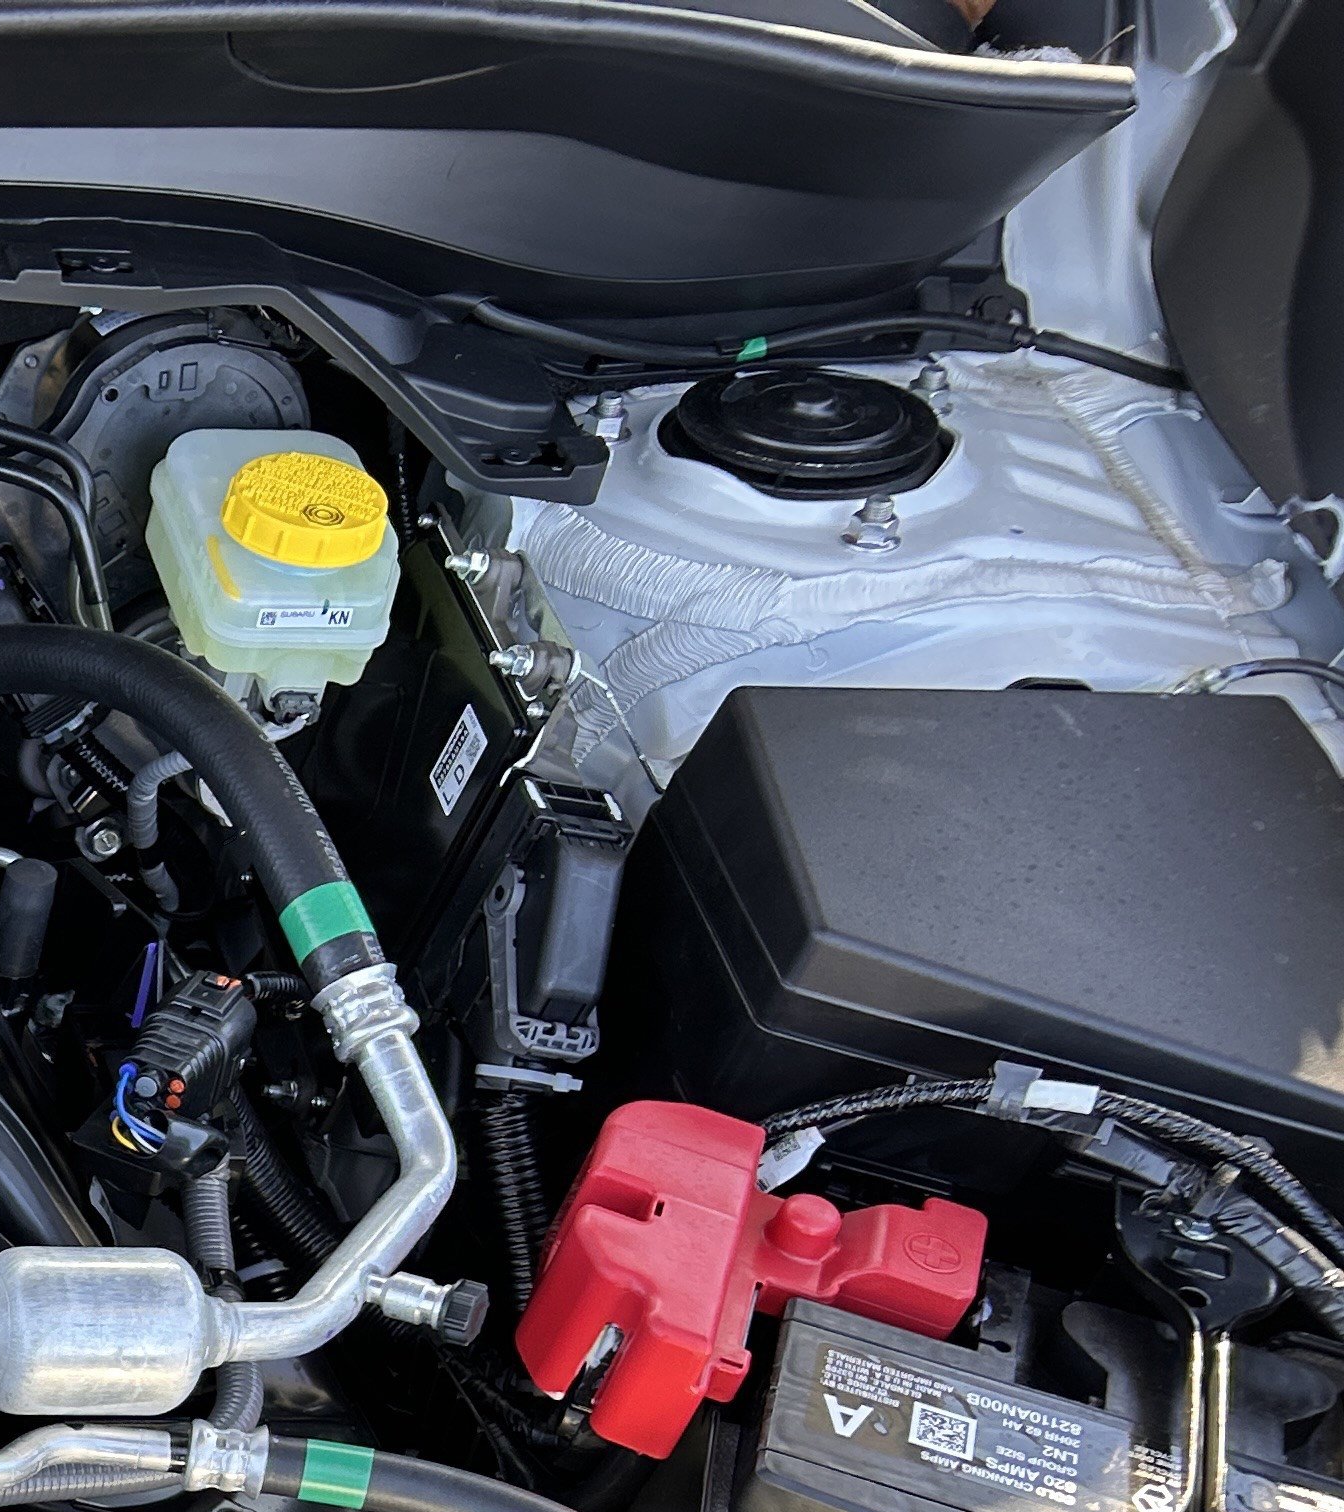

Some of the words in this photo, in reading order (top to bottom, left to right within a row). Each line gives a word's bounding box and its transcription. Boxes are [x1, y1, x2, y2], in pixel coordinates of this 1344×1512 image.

[280, 610, 316, 618] SUBARU
[327, 610, 350, 625] KN
[442, 791, 455, 807] L
[453, 763, 466, 786] D
[843, 1362, 871, 1376] WITH
[854, 1372, 869, 1382] WI
[881, 1365, 933, 1387] IMPORTED
[901, 1379, 913, 1389] IN
[913, 1383, 943, 1398] MADE
[932, 1381, 955, 1394] AND
[835, 1382, 901, 1408] DISTRIBUTED
[824, 1393, 874, 1438] A
[963, 1391, 1084, 1436] 82110AN00B
[1000, 1417, 1024, 1432] AH
[1023, 1424, 1043, 1437] 62
[1043, 1429, 1082, 1449] 20HR
[918, 1449, 960, 1470] AMPS
[993, 1444, 1026, 1462] SIZE
[1040, 1443, 1080, 1465] LN2
[983, 1455, 1041, 1483] AMPS
[1026, 1455, 1079, 1477] GROUP
[959, 1462, 1035, 1493] CRANKING
